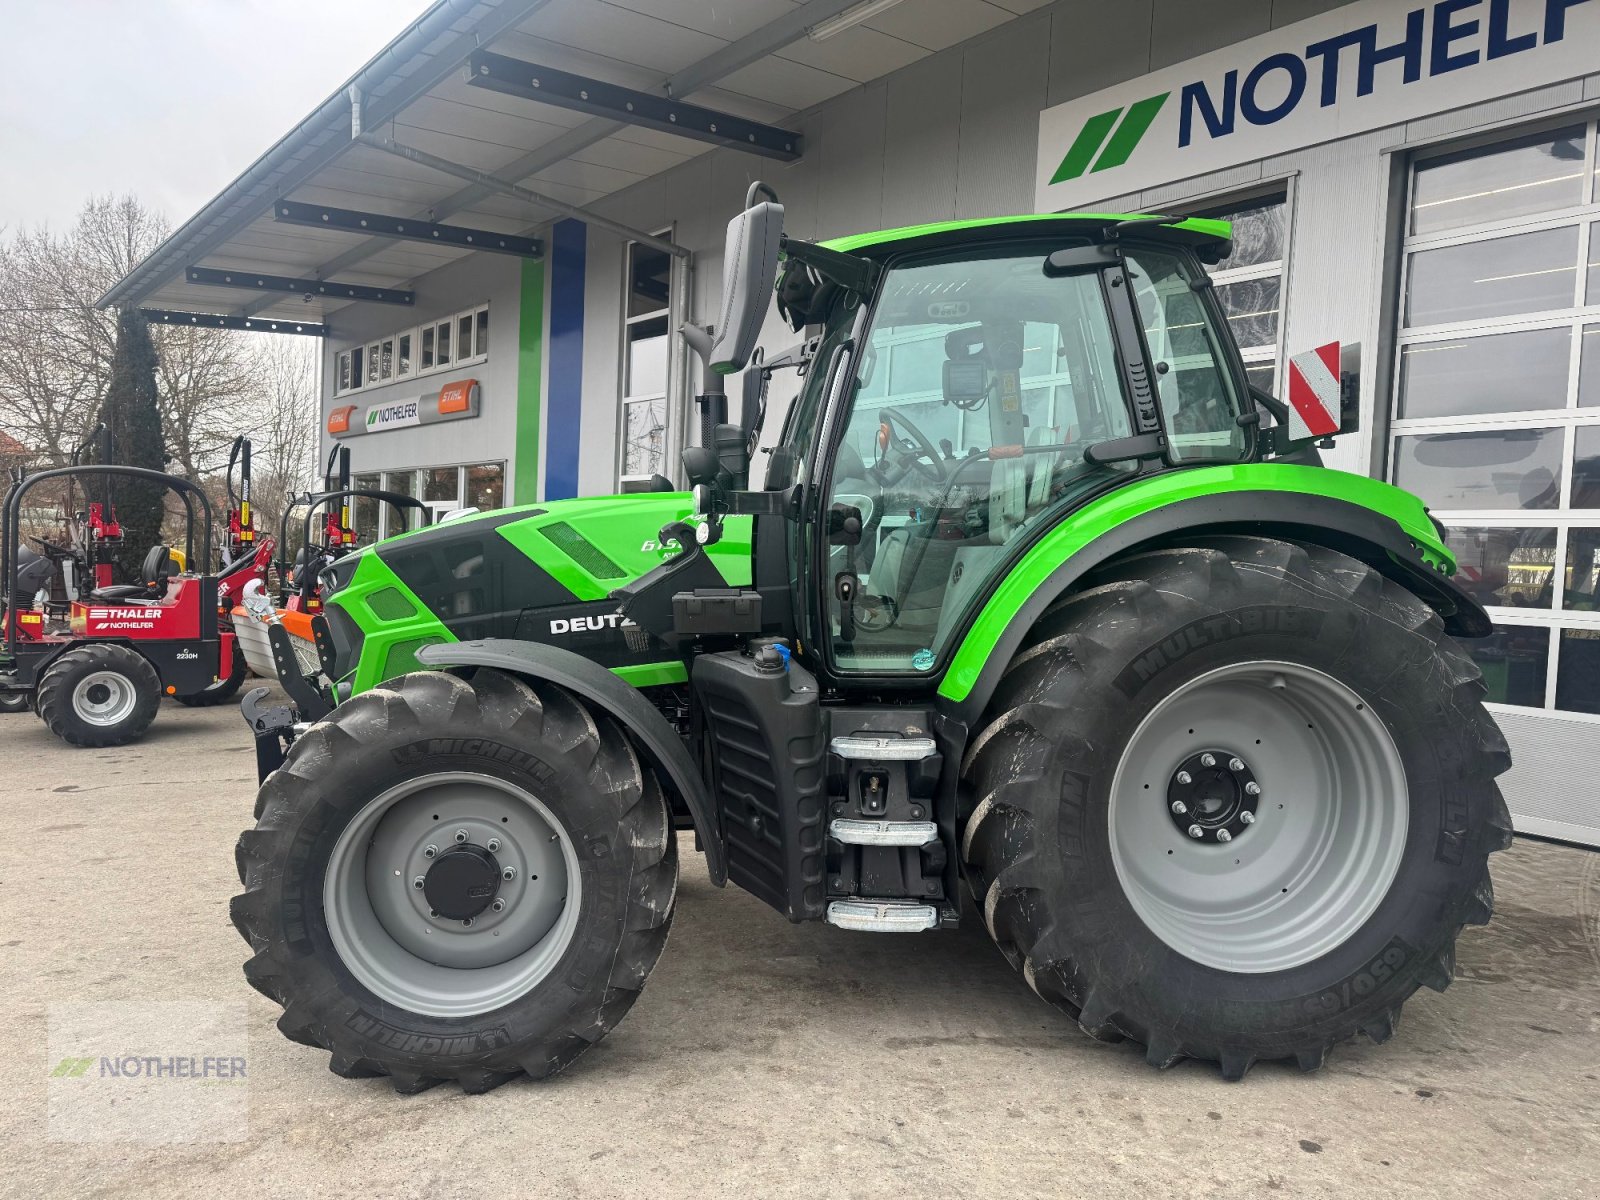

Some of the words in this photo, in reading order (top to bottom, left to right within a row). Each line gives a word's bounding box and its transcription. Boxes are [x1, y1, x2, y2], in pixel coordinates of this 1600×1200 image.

[442, 390, 463, 403] STIHL
[330, 412, 345, 424] STIHL
[378, 402, 418, 423] NOTHELFER
[108, 609, 162, 619] THALER
[428, 738, 555, 781] MICHELIN
[349, 1014, 478, 1056] MICHELIN
